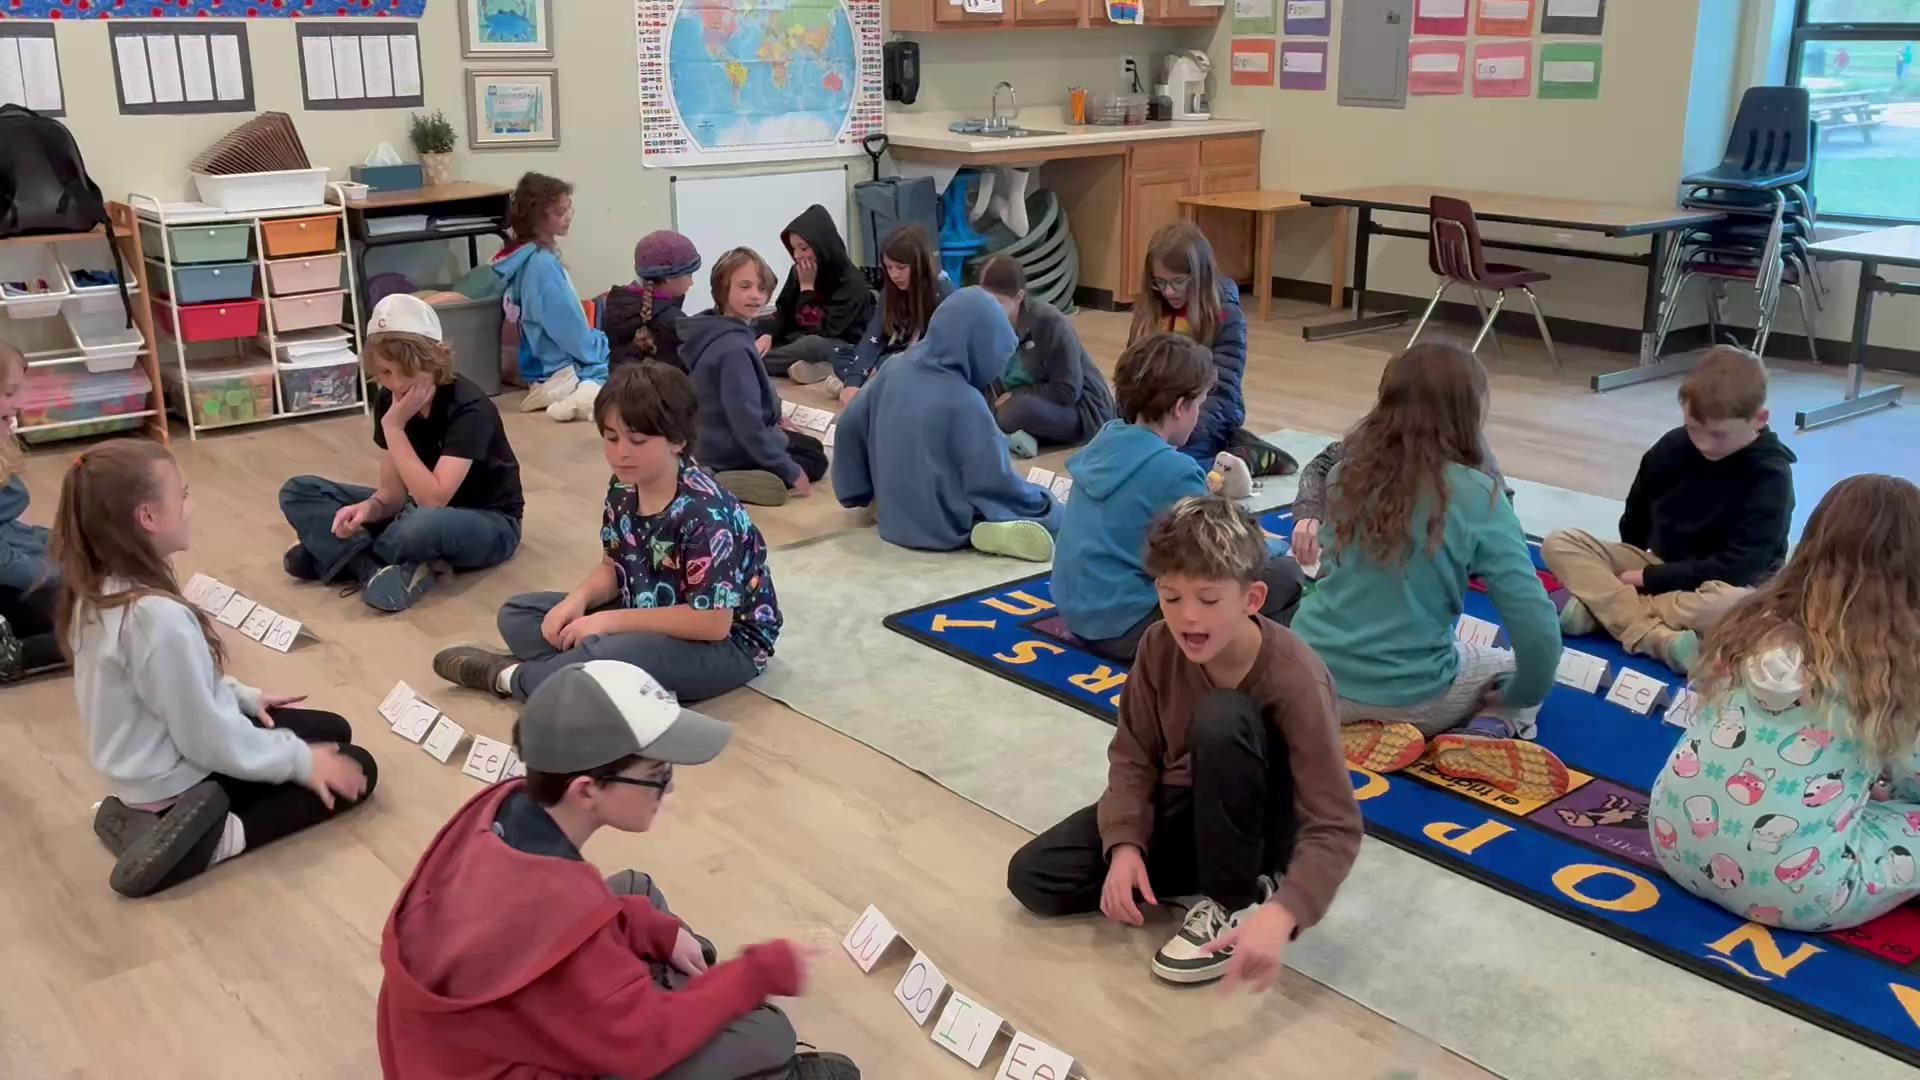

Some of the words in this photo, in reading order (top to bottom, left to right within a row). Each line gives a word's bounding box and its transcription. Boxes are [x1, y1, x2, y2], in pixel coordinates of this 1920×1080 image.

[978, 590, 1056, 615] U
[931, 614, 996, 632] T
[993, 640, 1066, 664] S
[1614, 674, 1651, 706] Ee
[469, 742, 499, 774] Ee
[1493, 793, 1520, 806] el
[1423, 819, 1517, 855] P
[1552, 864, 1660, 912] O
[901, 962, 933, 1014] Oo
[939, 998, 982, 1053] Ii
[1006, 1042, 1055, 1080] Ee
